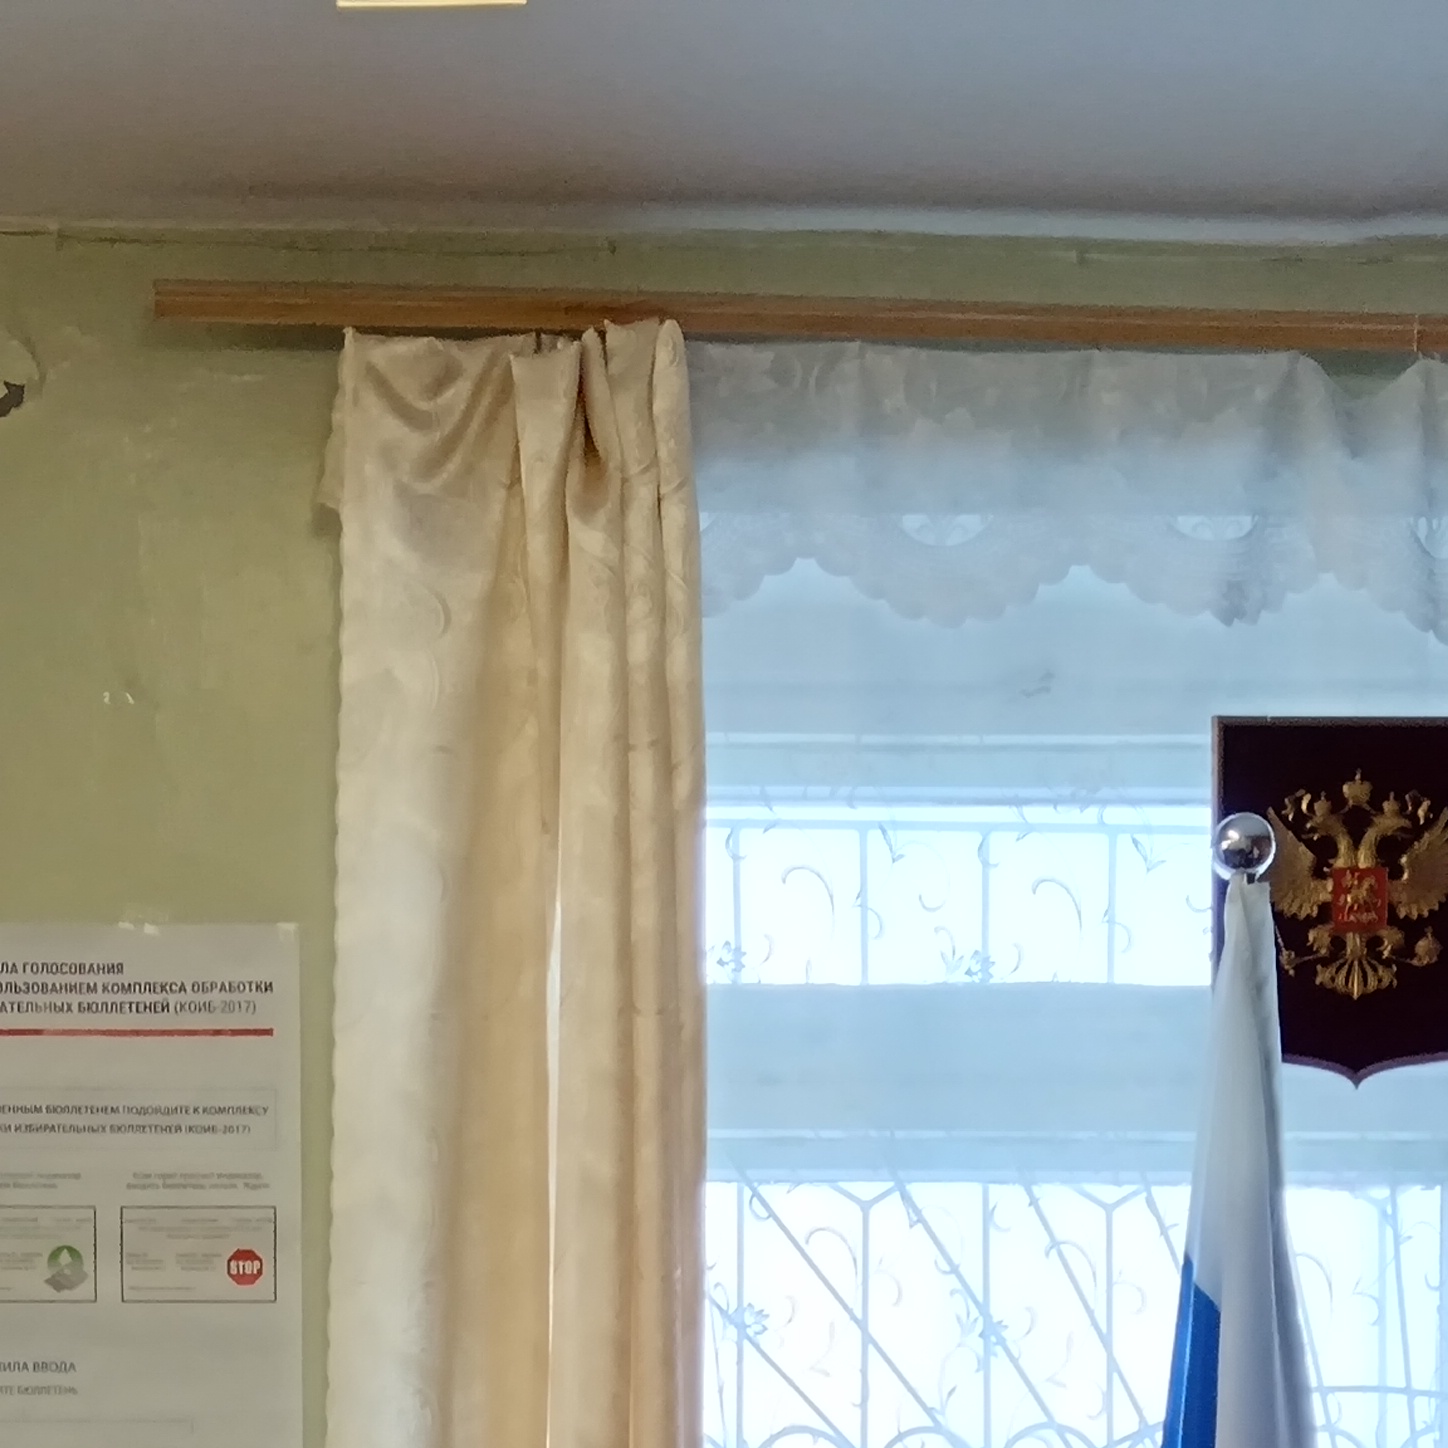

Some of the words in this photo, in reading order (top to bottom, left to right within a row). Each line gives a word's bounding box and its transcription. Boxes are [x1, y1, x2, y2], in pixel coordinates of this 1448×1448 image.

[23, 962, 124, 975] ГОЛОСОВАНИЯ
[102, 981, 187, 995] КОМПЛЕКСА
[191, 981, 274, 994] ОБРАБОТКИ
[77, 998, 170, 1014] БЮЛЛЕТЕНЕЙ
[174, 1000, 256, 1015] (КОИБ-2017)
[230, 1260, 261, 1275] STOP
[32, 1361, 77, 1374] ВВОДА
